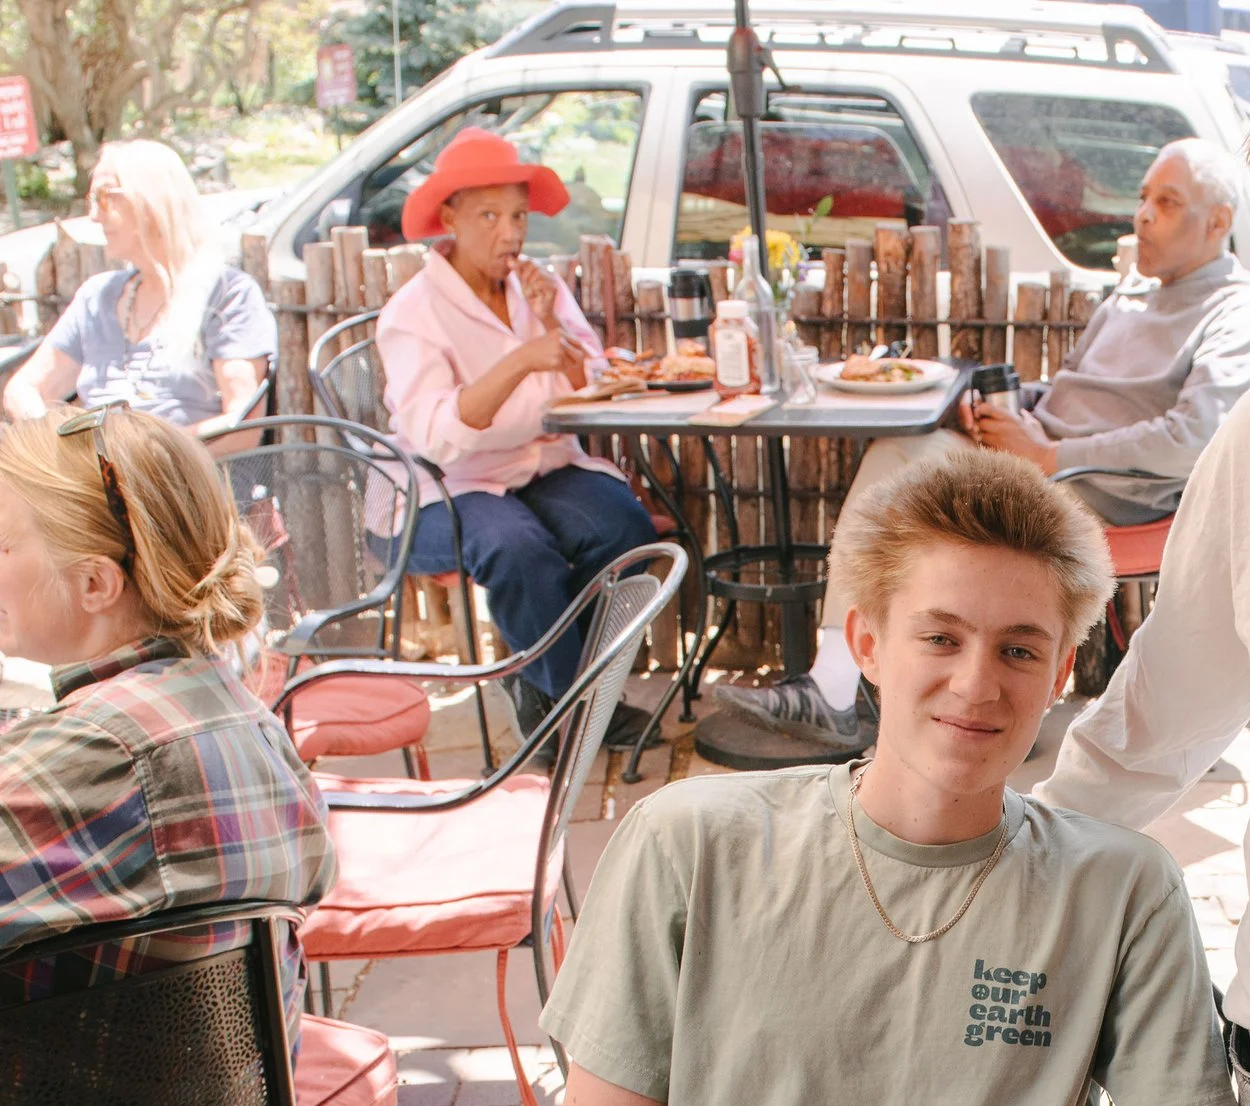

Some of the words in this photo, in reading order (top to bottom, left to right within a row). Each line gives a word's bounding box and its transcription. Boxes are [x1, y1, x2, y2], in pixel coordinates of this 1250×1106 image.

[973, 959, 1047, 994] keep
[971, 983, 1027, 1005] our
[969, 1003, 1051, 1027] earth
[964, 1022, 1052, 1047] green
